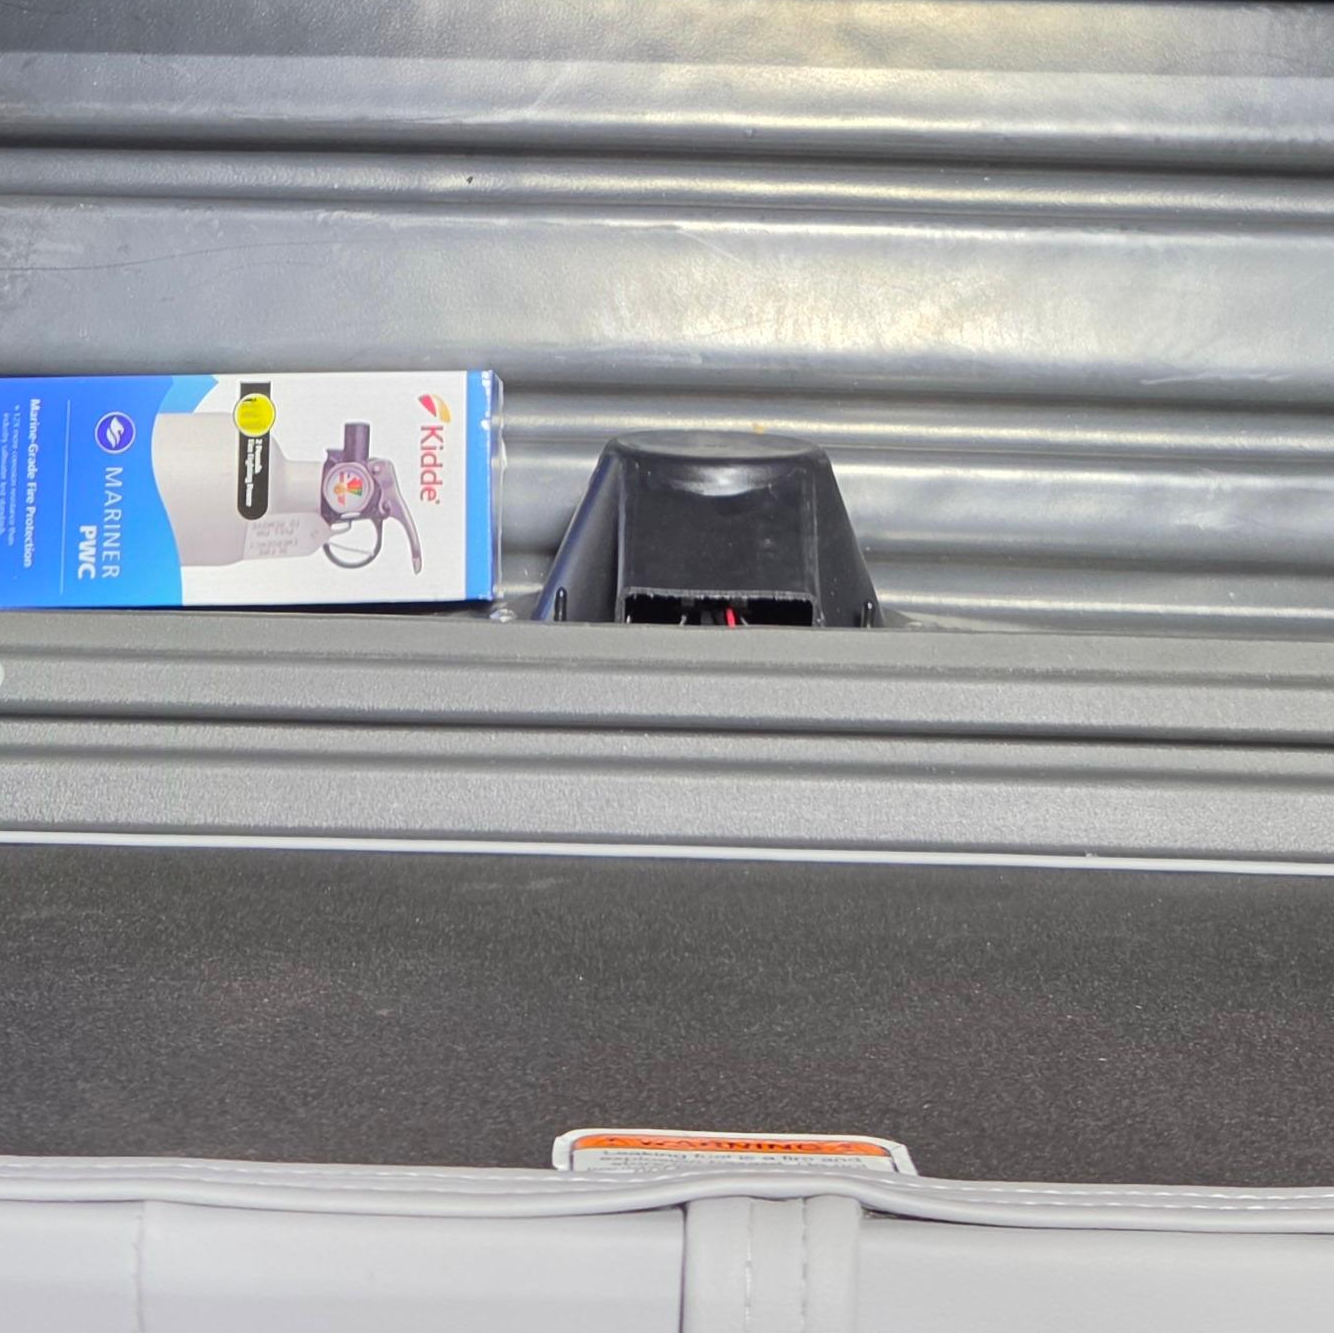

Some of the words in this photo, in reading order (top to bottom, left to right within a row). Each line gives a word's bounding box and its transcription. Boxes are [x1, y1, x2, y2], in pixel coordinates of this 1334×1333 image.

[25, 398, 41, 479] Marine-Grade
[419, 425, 444, 502] Kidde
[25, 481, 38, 504] Fire
[101, 466, 124, 578] MARINER
[22, 505, 37, 569] Protection
[77, 524, 97, 580] PWC
[639, 1138, 823, 1151] WARNING
